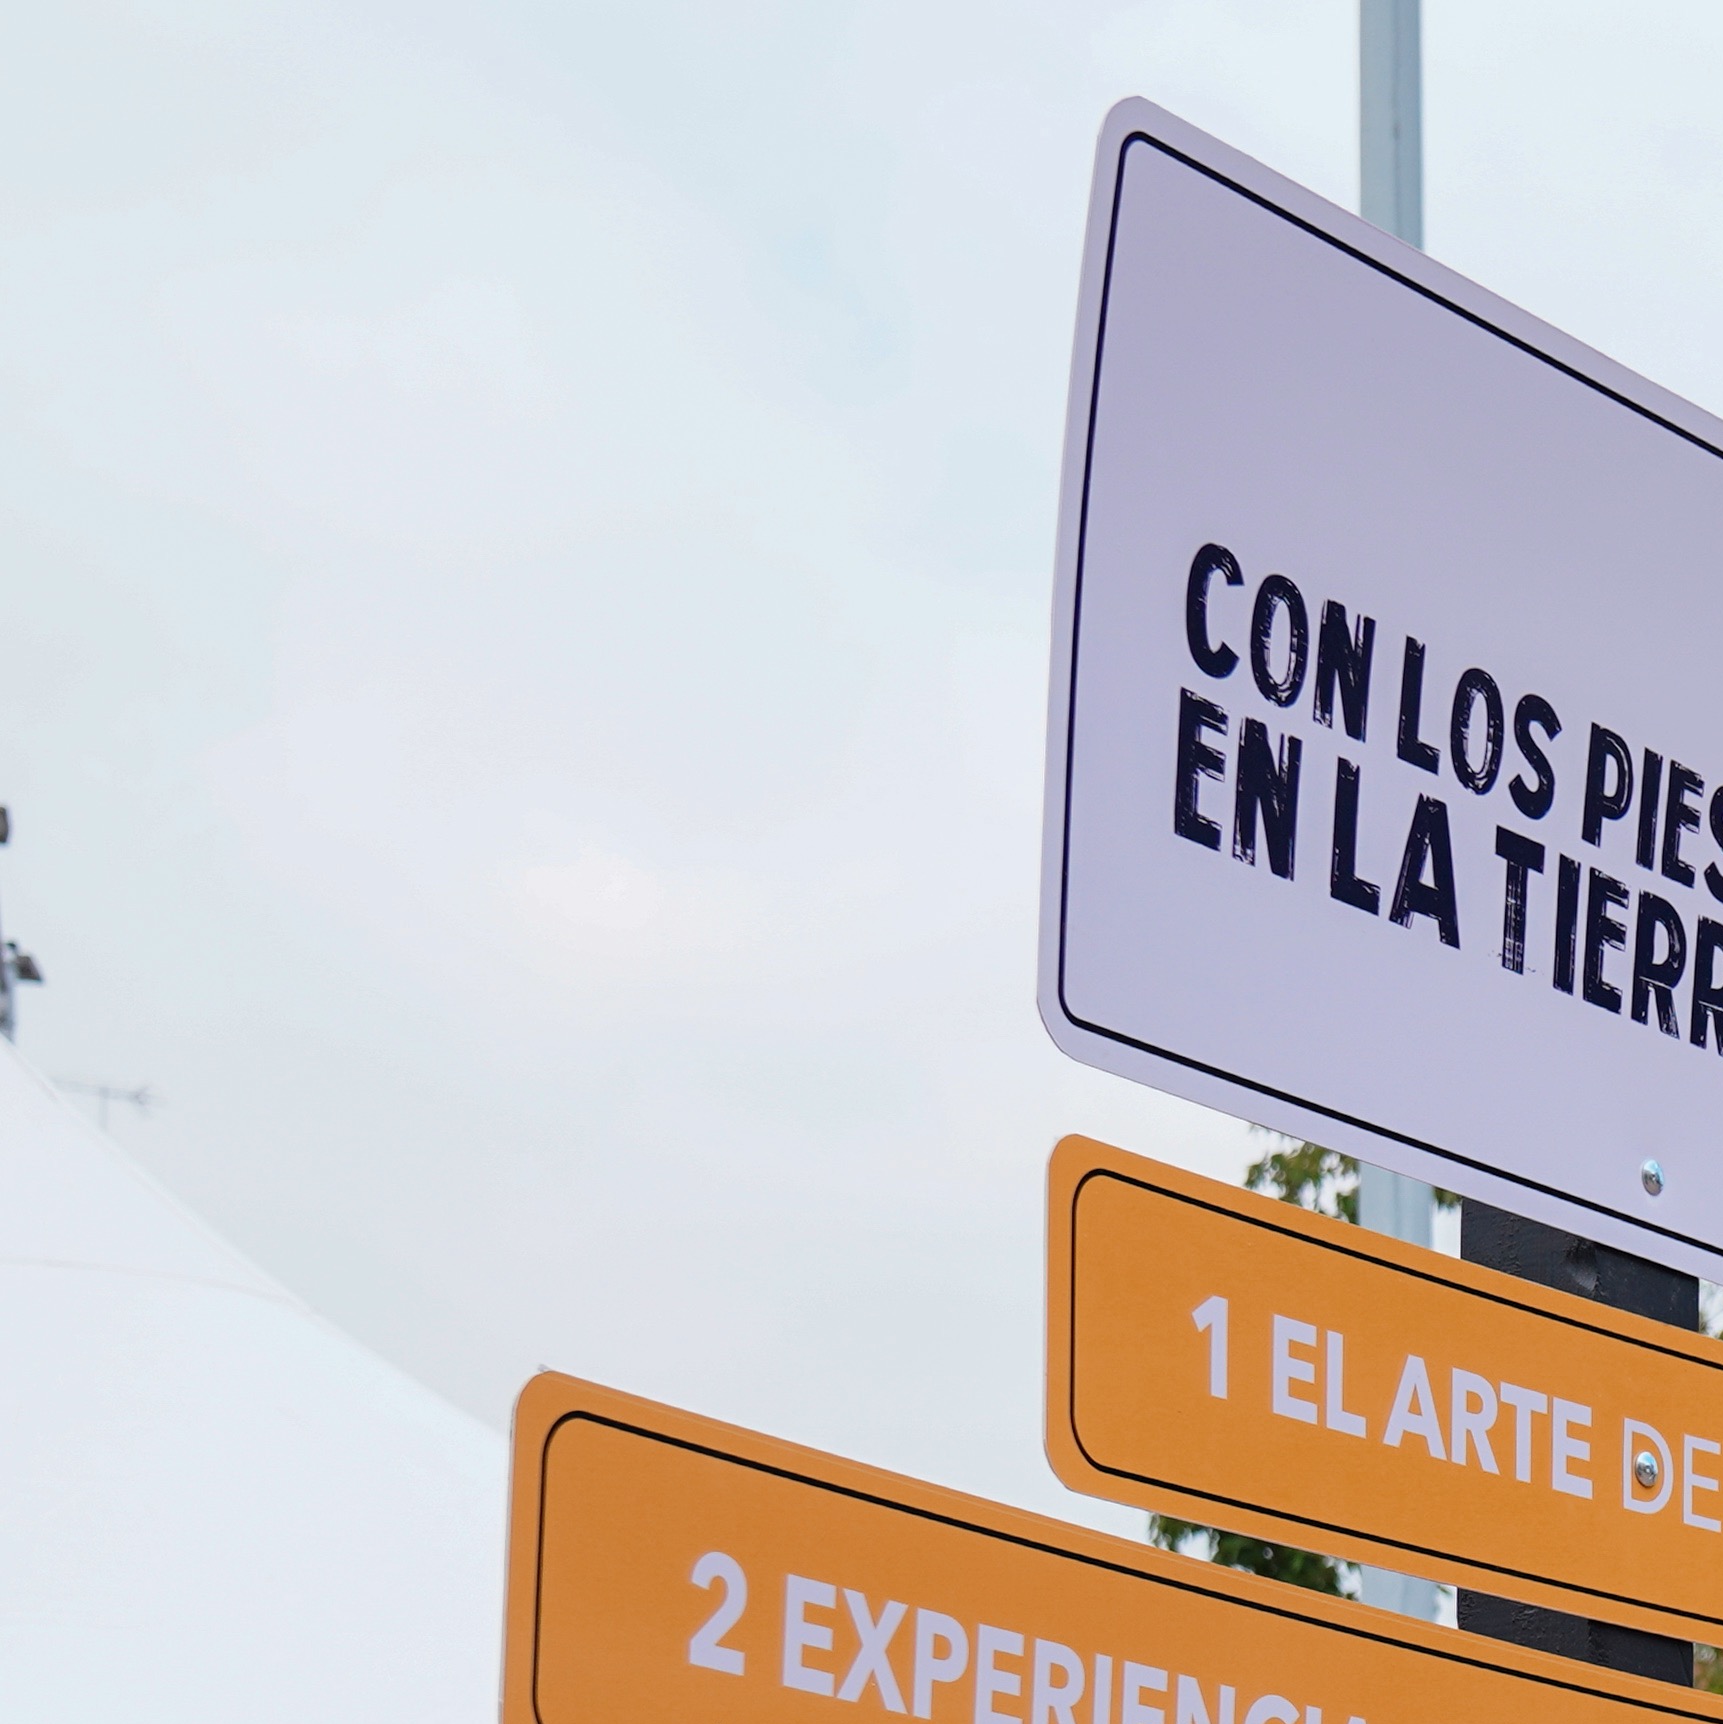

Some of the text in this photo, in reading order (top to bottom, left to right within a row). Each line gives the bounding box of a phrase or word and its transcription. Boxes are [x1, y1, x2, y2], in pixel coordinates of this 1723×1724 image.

[1184, 541, 1377, 744] CON
[1396, 634, 1564, 822] LOS
[1173, 685, 1303, 883] EN
[1330, 755, 1462, 951] LA
[1190, 1294, 1229, 1400] 1
[1271, 1313, 1368, 1439] EL
[1381, 1353, 1594, 1500] ARTE
[1621, 1416, 1723, 1533] DE
[687, 1550, 748, 1677] 2
